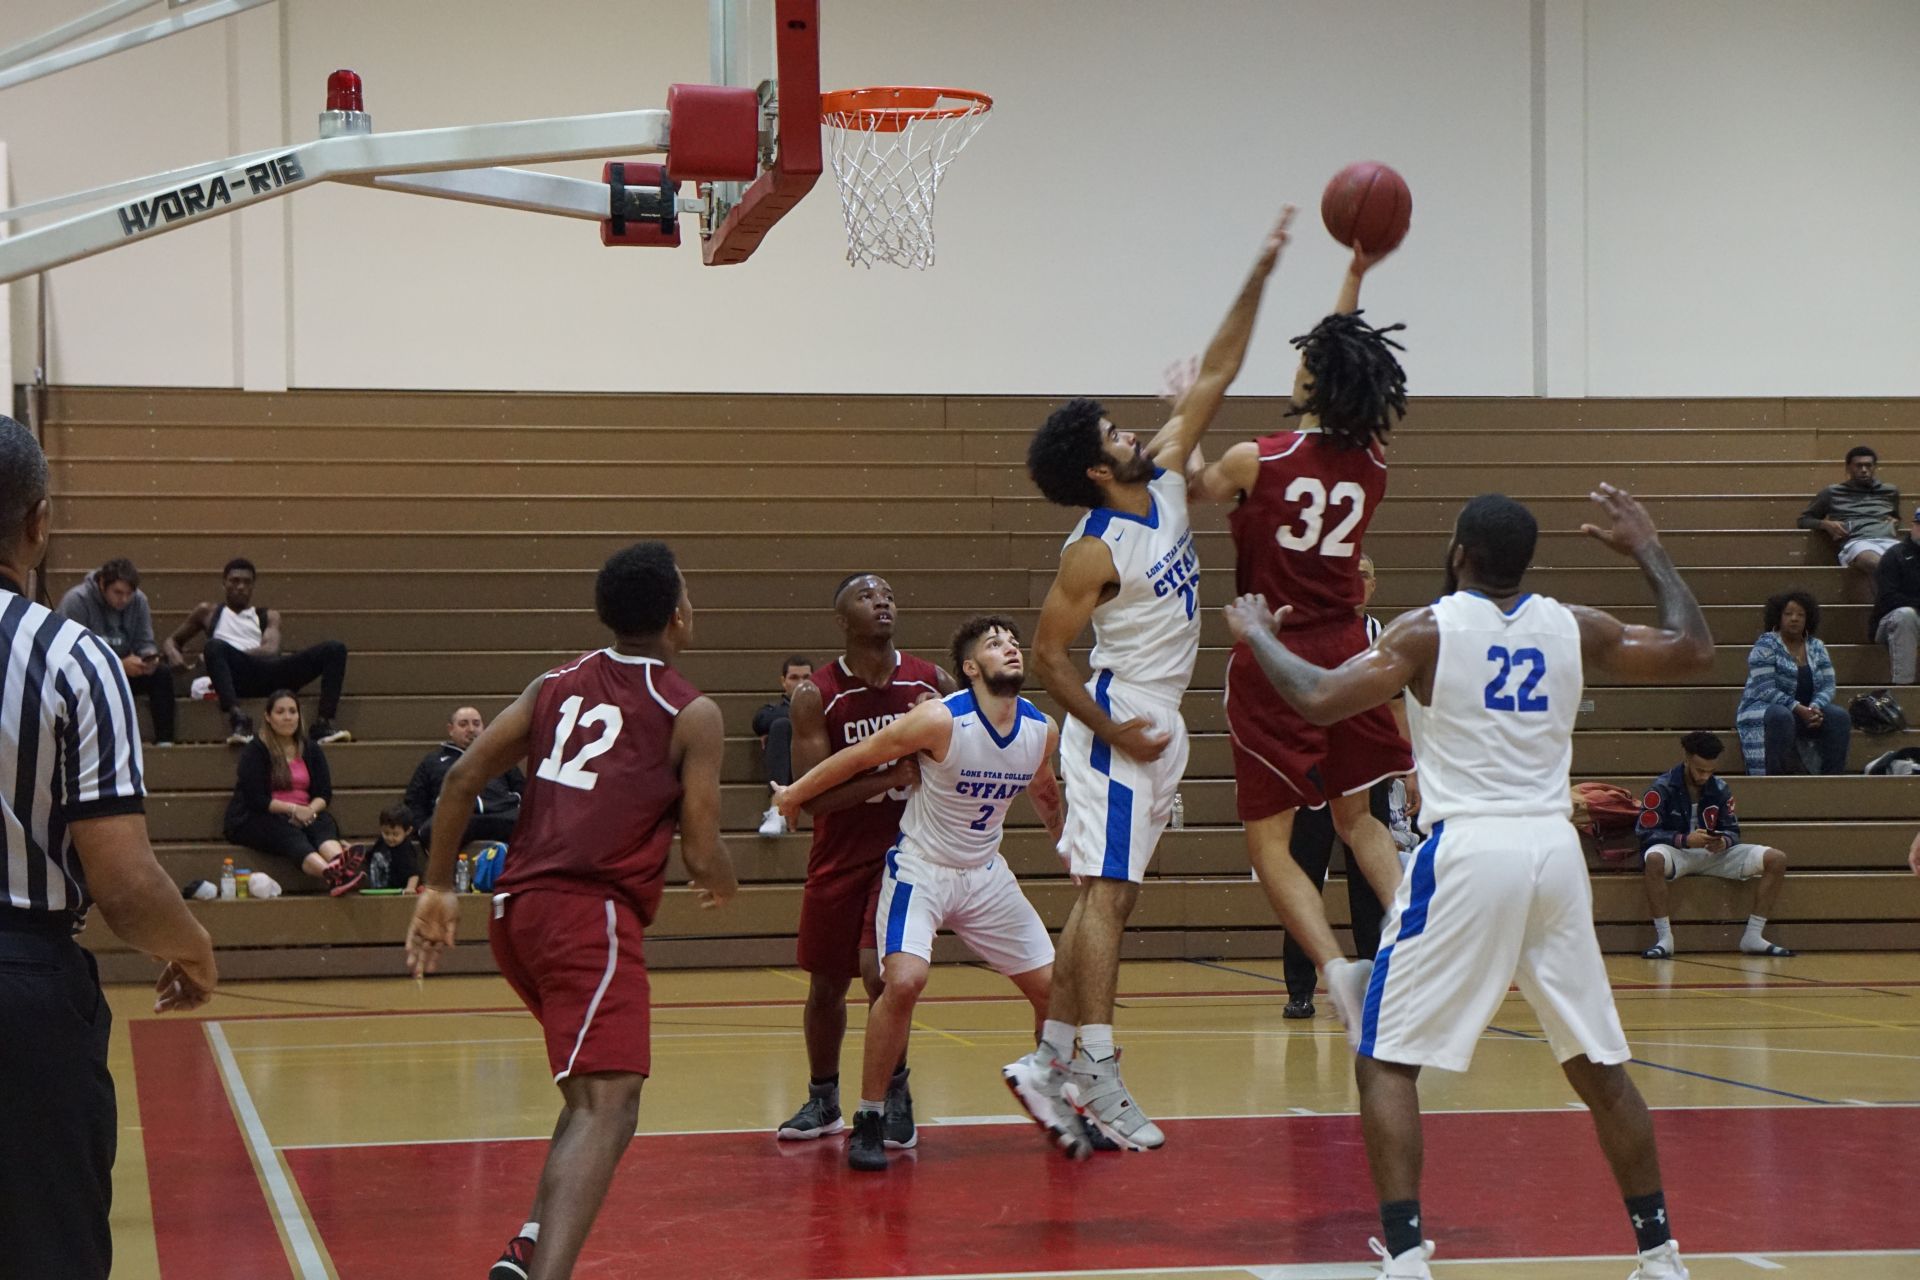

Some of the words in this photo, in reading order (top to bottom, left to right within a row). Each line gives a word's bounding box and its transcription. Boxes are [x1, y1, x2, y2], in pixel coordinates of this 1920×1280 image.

[118, 153, 305, 235] HYDRA-RIB
[1275, 477, 1366, 557] 32
[1146, 561, 1164, 579] LONE
[1163, 546, 1178, 563] STAR
[1484, 645, 1549, 713] 22
[536, 695, 624, 791] 12
[960, 769, 982, 778] LONE
[983, 771, 1002, 780] STAR
[970, 804, 995, 832] 2
